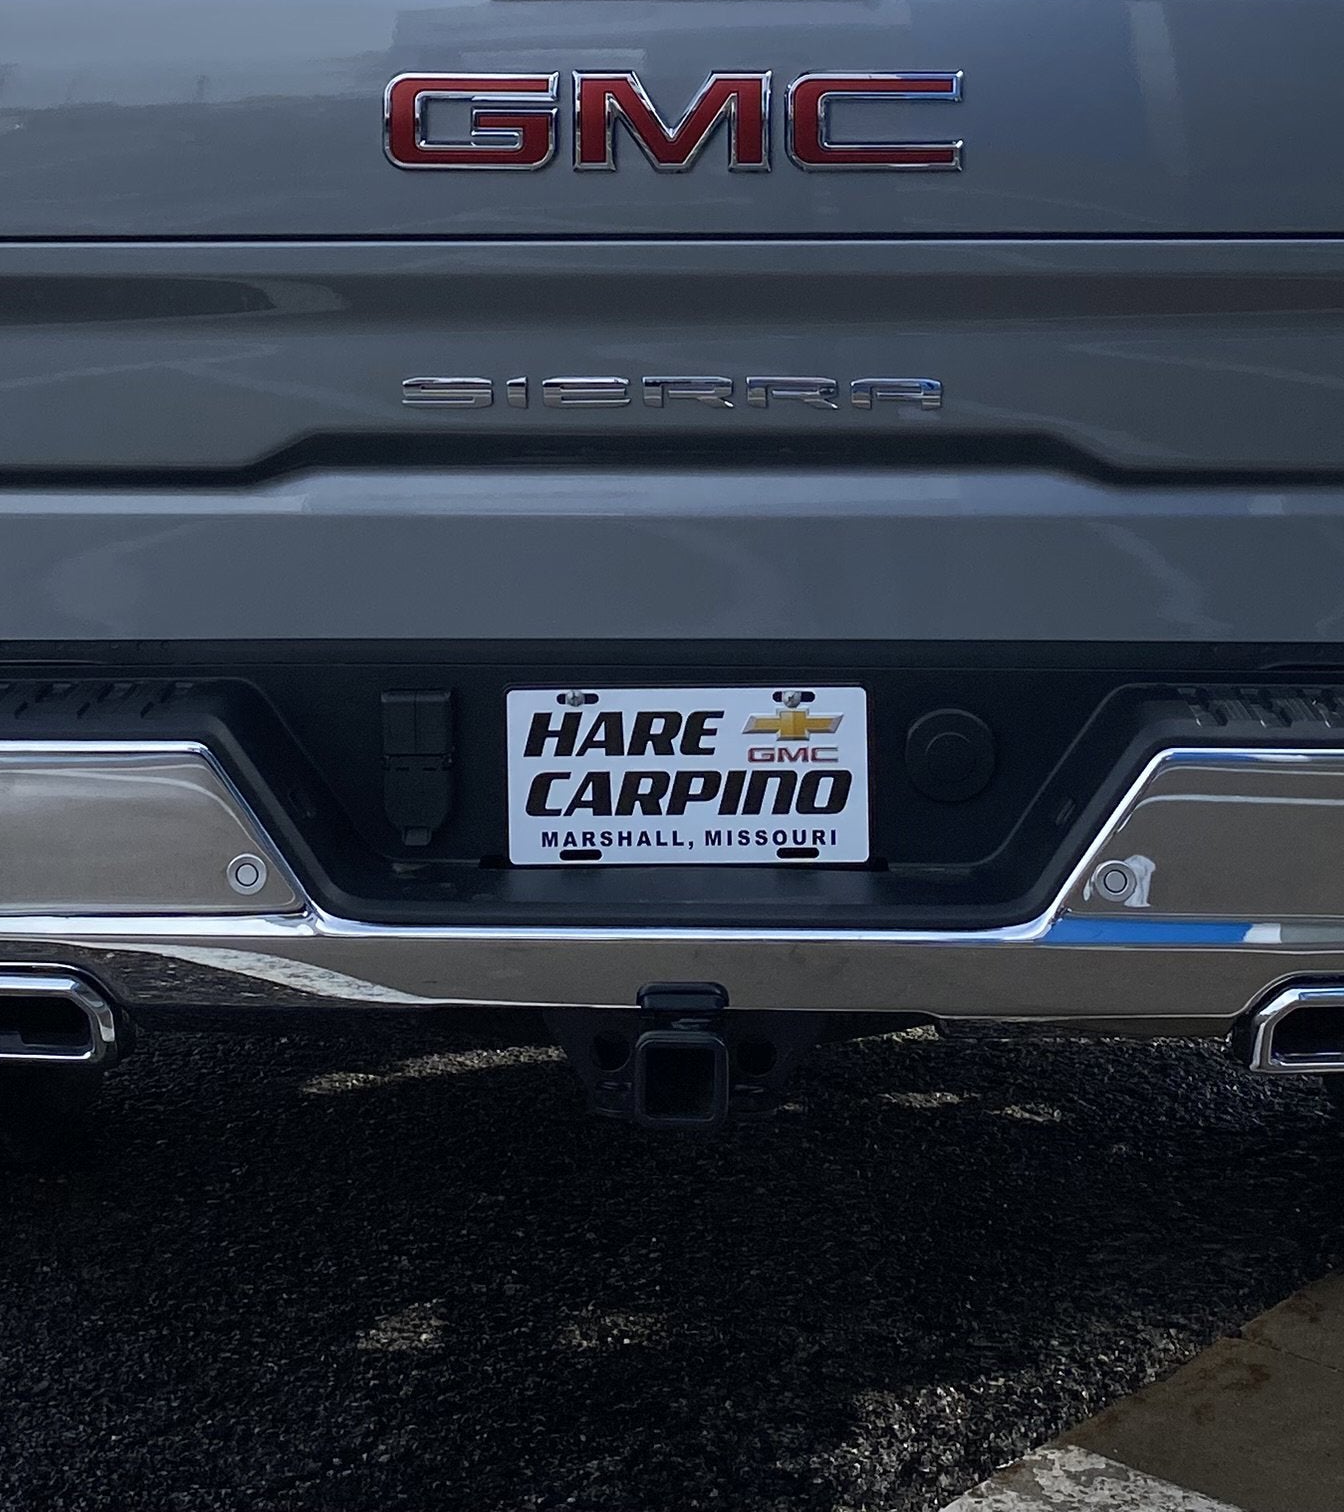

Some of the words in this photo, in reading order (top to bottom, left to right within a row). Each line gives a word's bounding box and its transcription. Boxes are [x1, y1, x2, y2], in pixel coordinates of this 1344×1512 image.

[383, 70, 965, 174] GMC
[402, 376, 944, 409] SIERRA
[523, 710, 724, 757] HARE
[747, 746, 839, 763] GMC
[525, 770, 852, 816] CARPINO
[541, 831, 695, 850] MARSHALL,
[704, 829, 838, 846] MISSOURI
